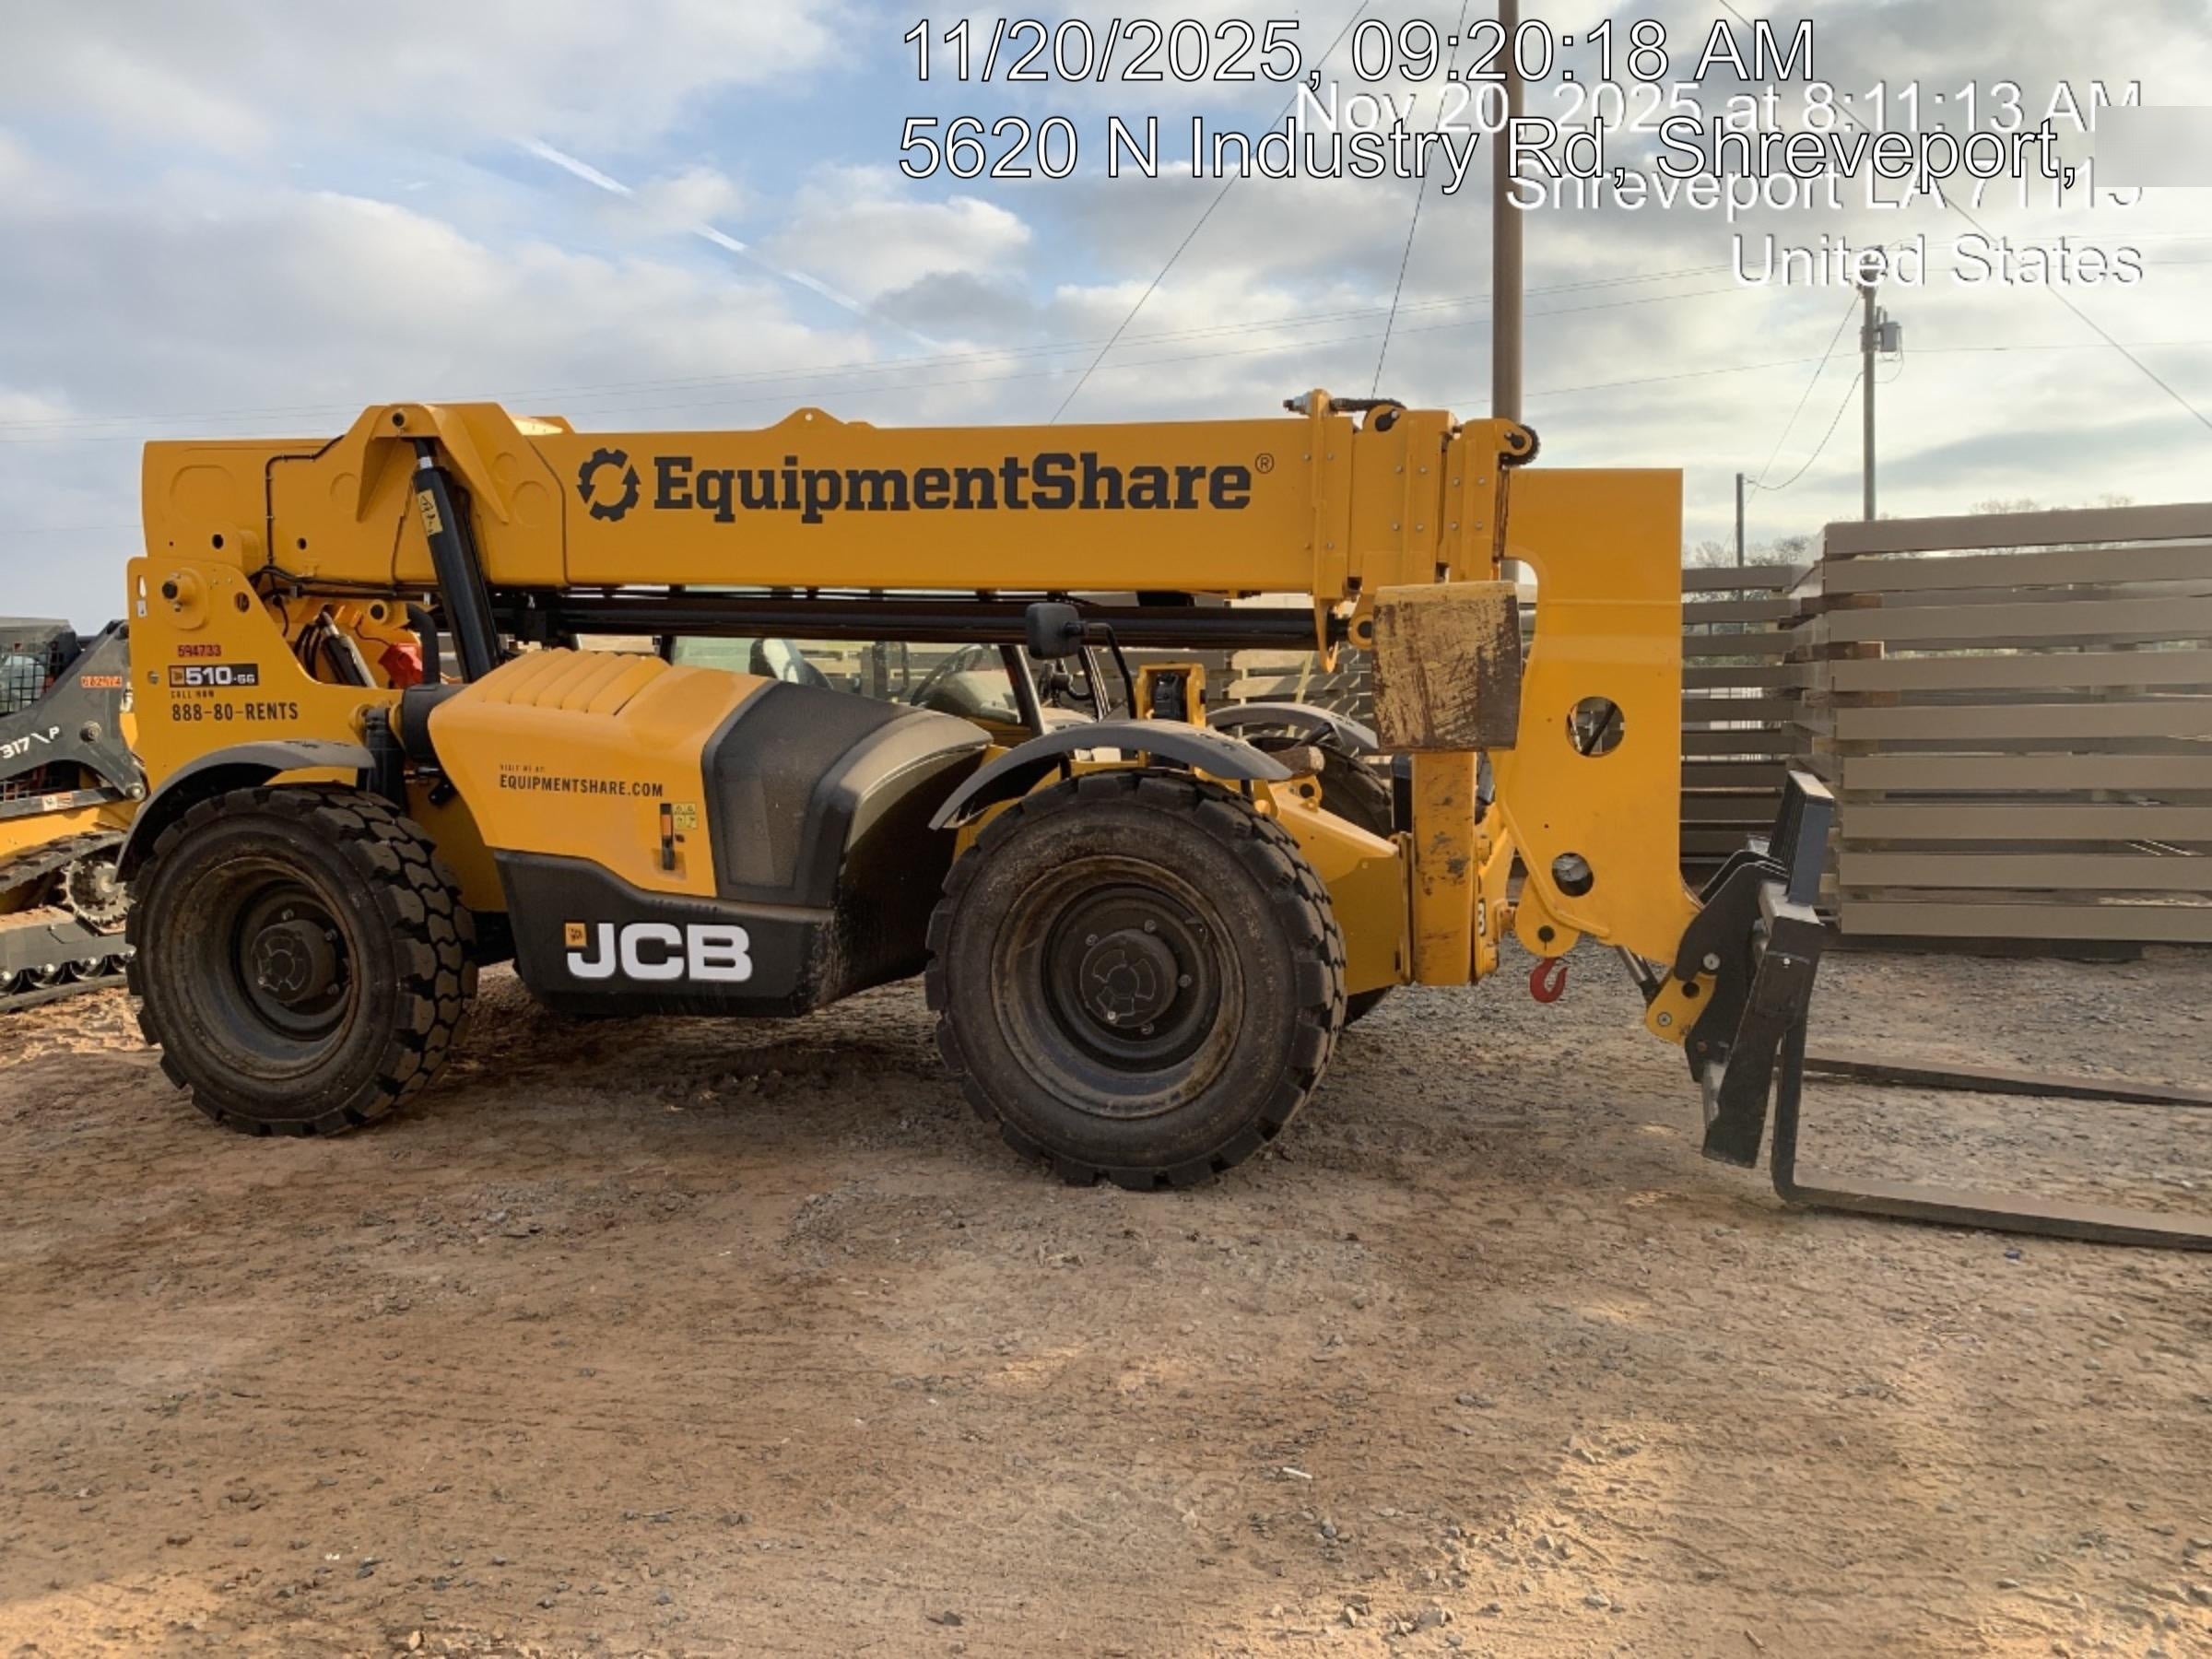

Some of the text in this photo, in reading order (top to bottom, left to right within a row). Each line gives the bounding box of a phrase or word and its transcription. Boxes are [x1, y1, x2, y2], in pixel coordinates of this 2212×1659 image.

[171, 701, 299, 722] 888-80-RENTS
[0, 736, 30, 759] 317
[500, 773, 664, 797] EQUIPMENTSHARE.COM
[565, 923, 753, 982] JCB
